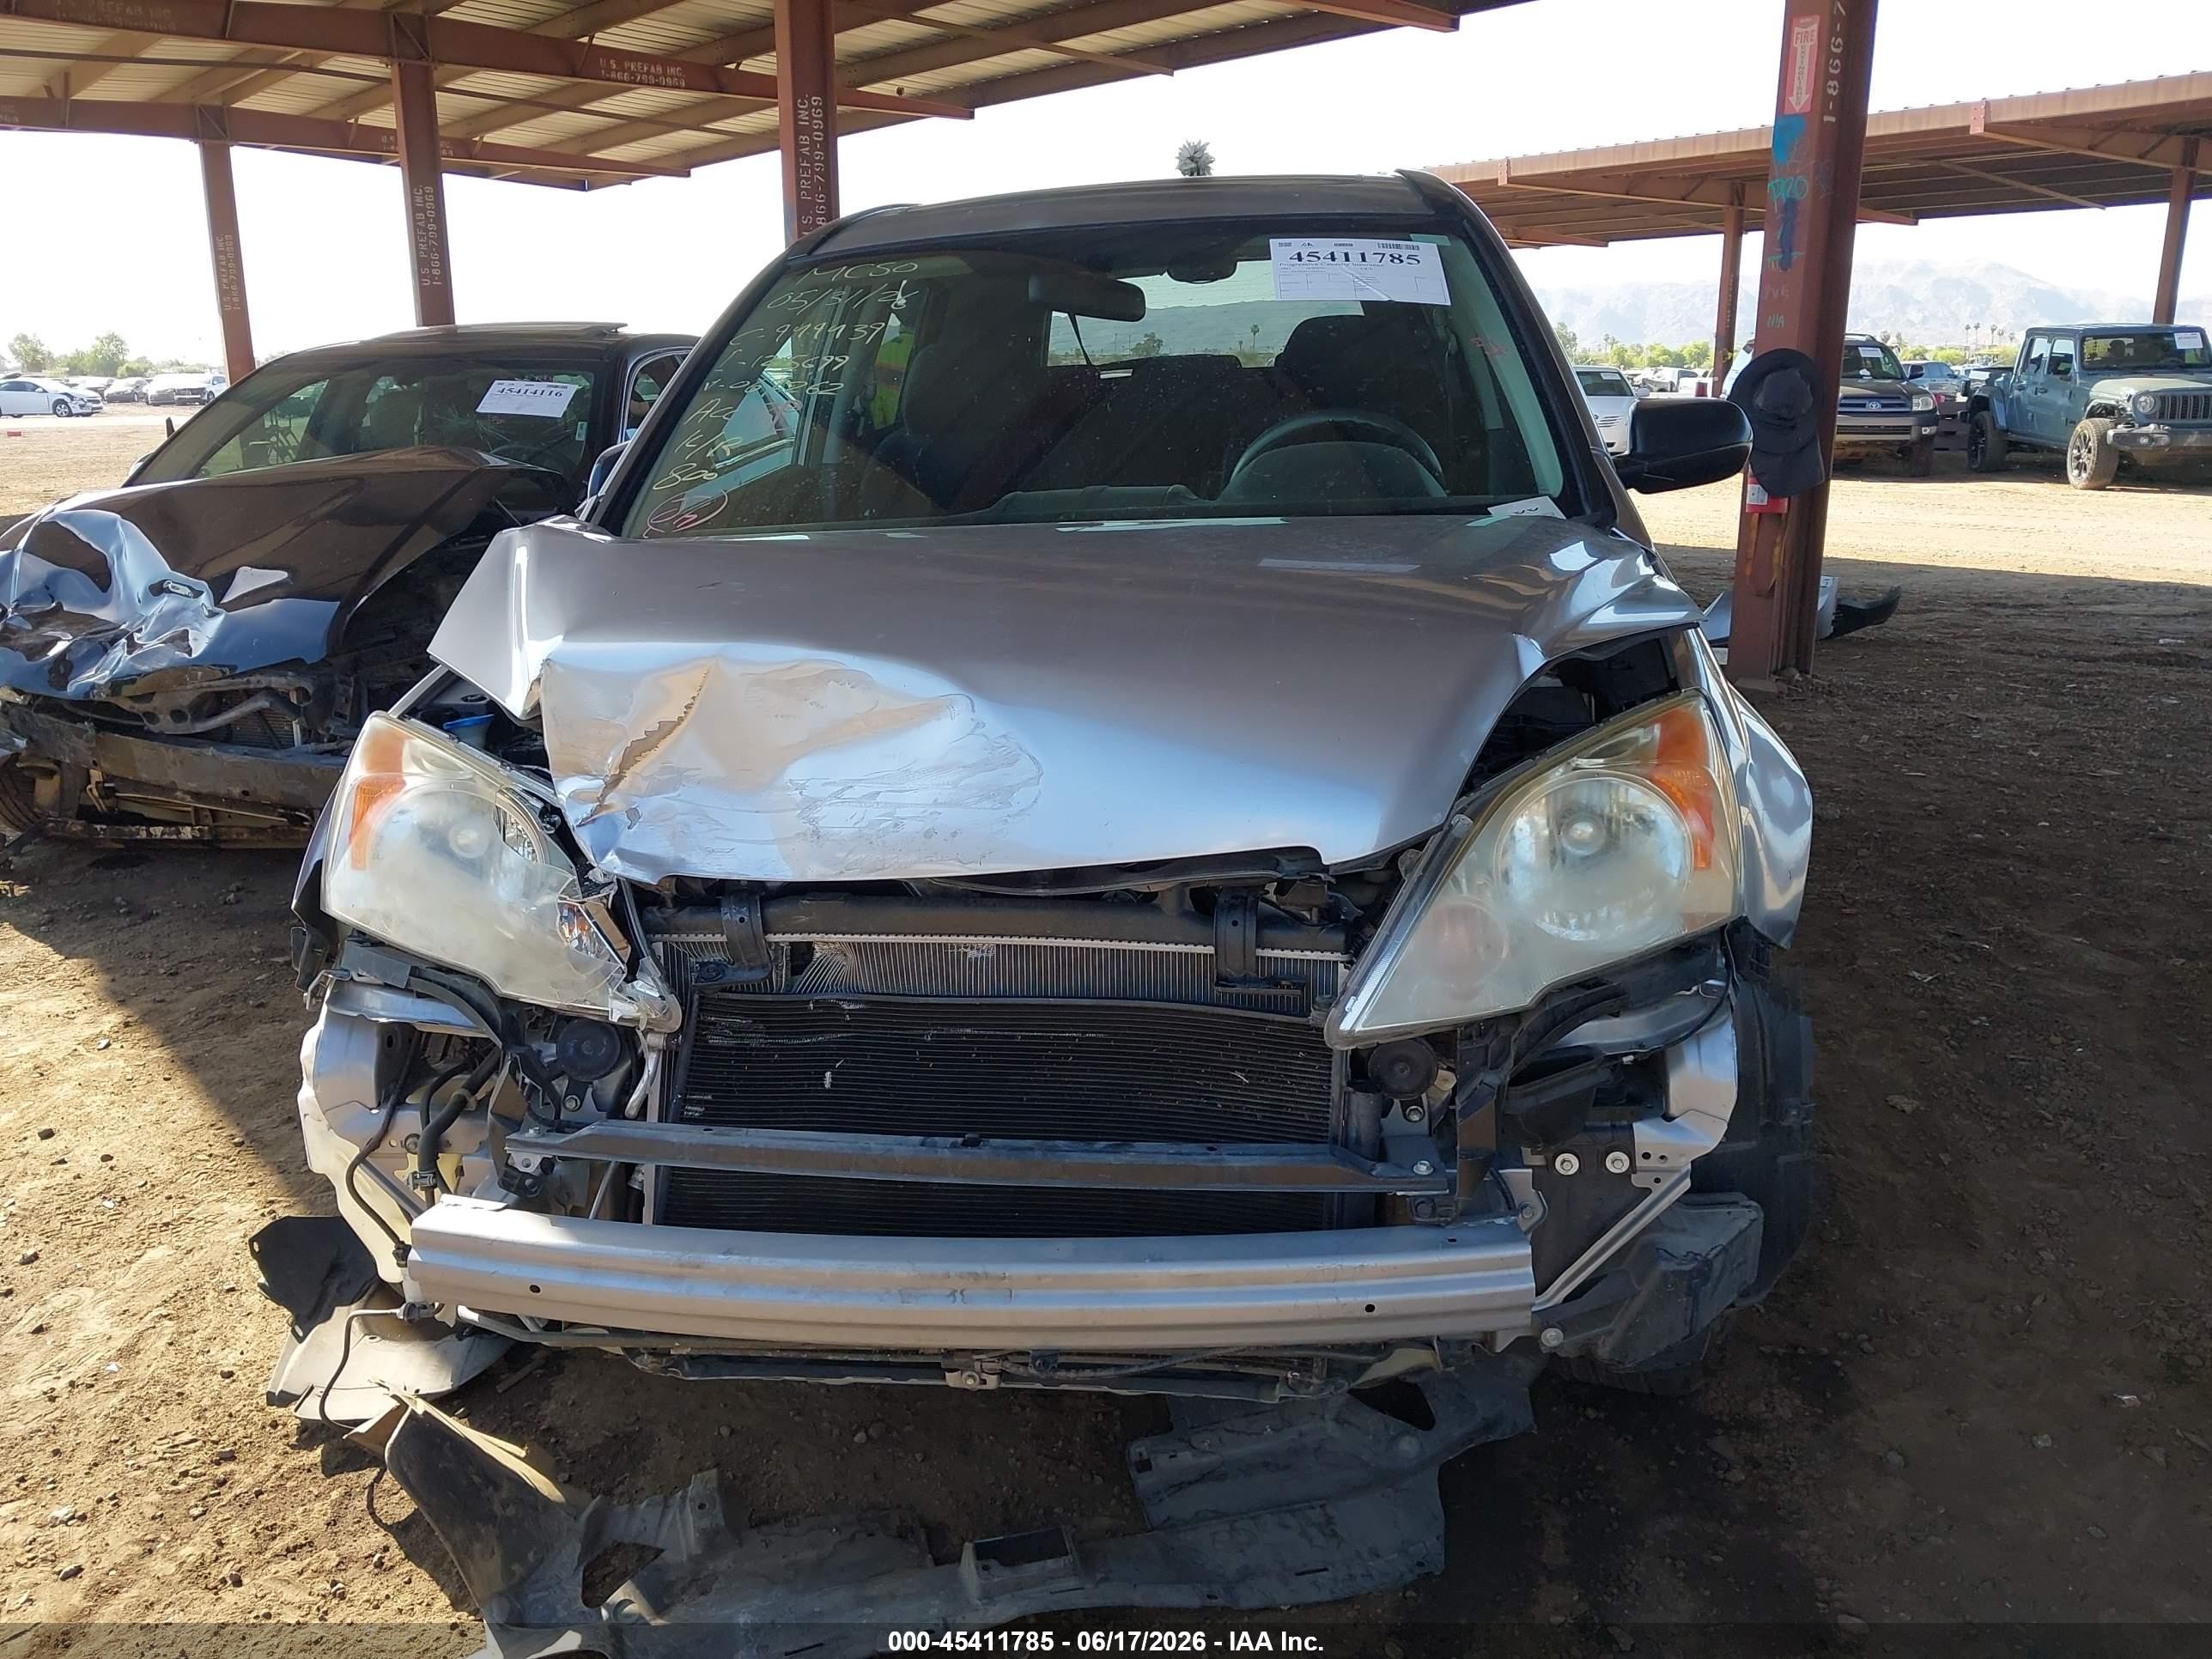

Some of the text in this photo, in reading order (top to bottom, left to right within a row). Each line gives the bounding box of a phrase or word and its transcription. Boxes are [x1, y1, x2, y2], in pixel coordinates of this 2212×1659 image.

[1795, 29, 1815, 45] FIRE
[624, 61, 663, 75] PREFAB
[666, 65, 686, 77] INC.
[797, 94, 809, 125] INC.
[799, 135, 812, 200] PREFAB
[413, 185, 431, 286] U.S. PREFAB INC.
[424, 185, 442, 286] 1-866-799-0969
[1289, 251, 1421, 265] 45411785
[496, 387, 563, 398] 45414116
